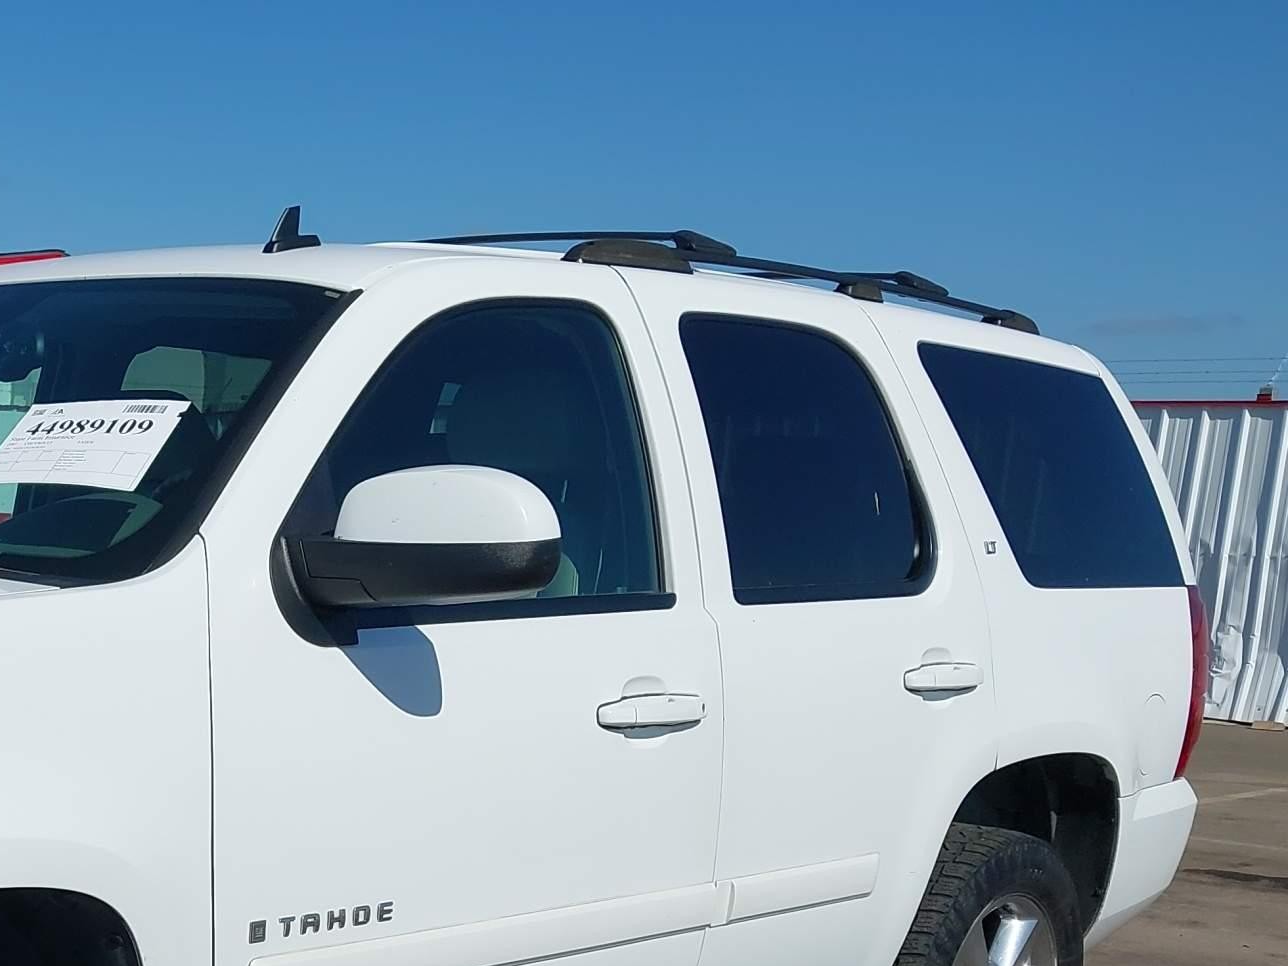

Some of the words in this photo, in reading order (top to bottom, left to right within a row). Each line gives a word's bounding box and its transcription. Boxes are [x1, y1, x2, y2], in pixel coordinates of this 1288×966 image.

[26, 419, 154, 436] 44989109
[984, 541, 997, 554] LT
[278, 901, 394, 937] TAHOE
